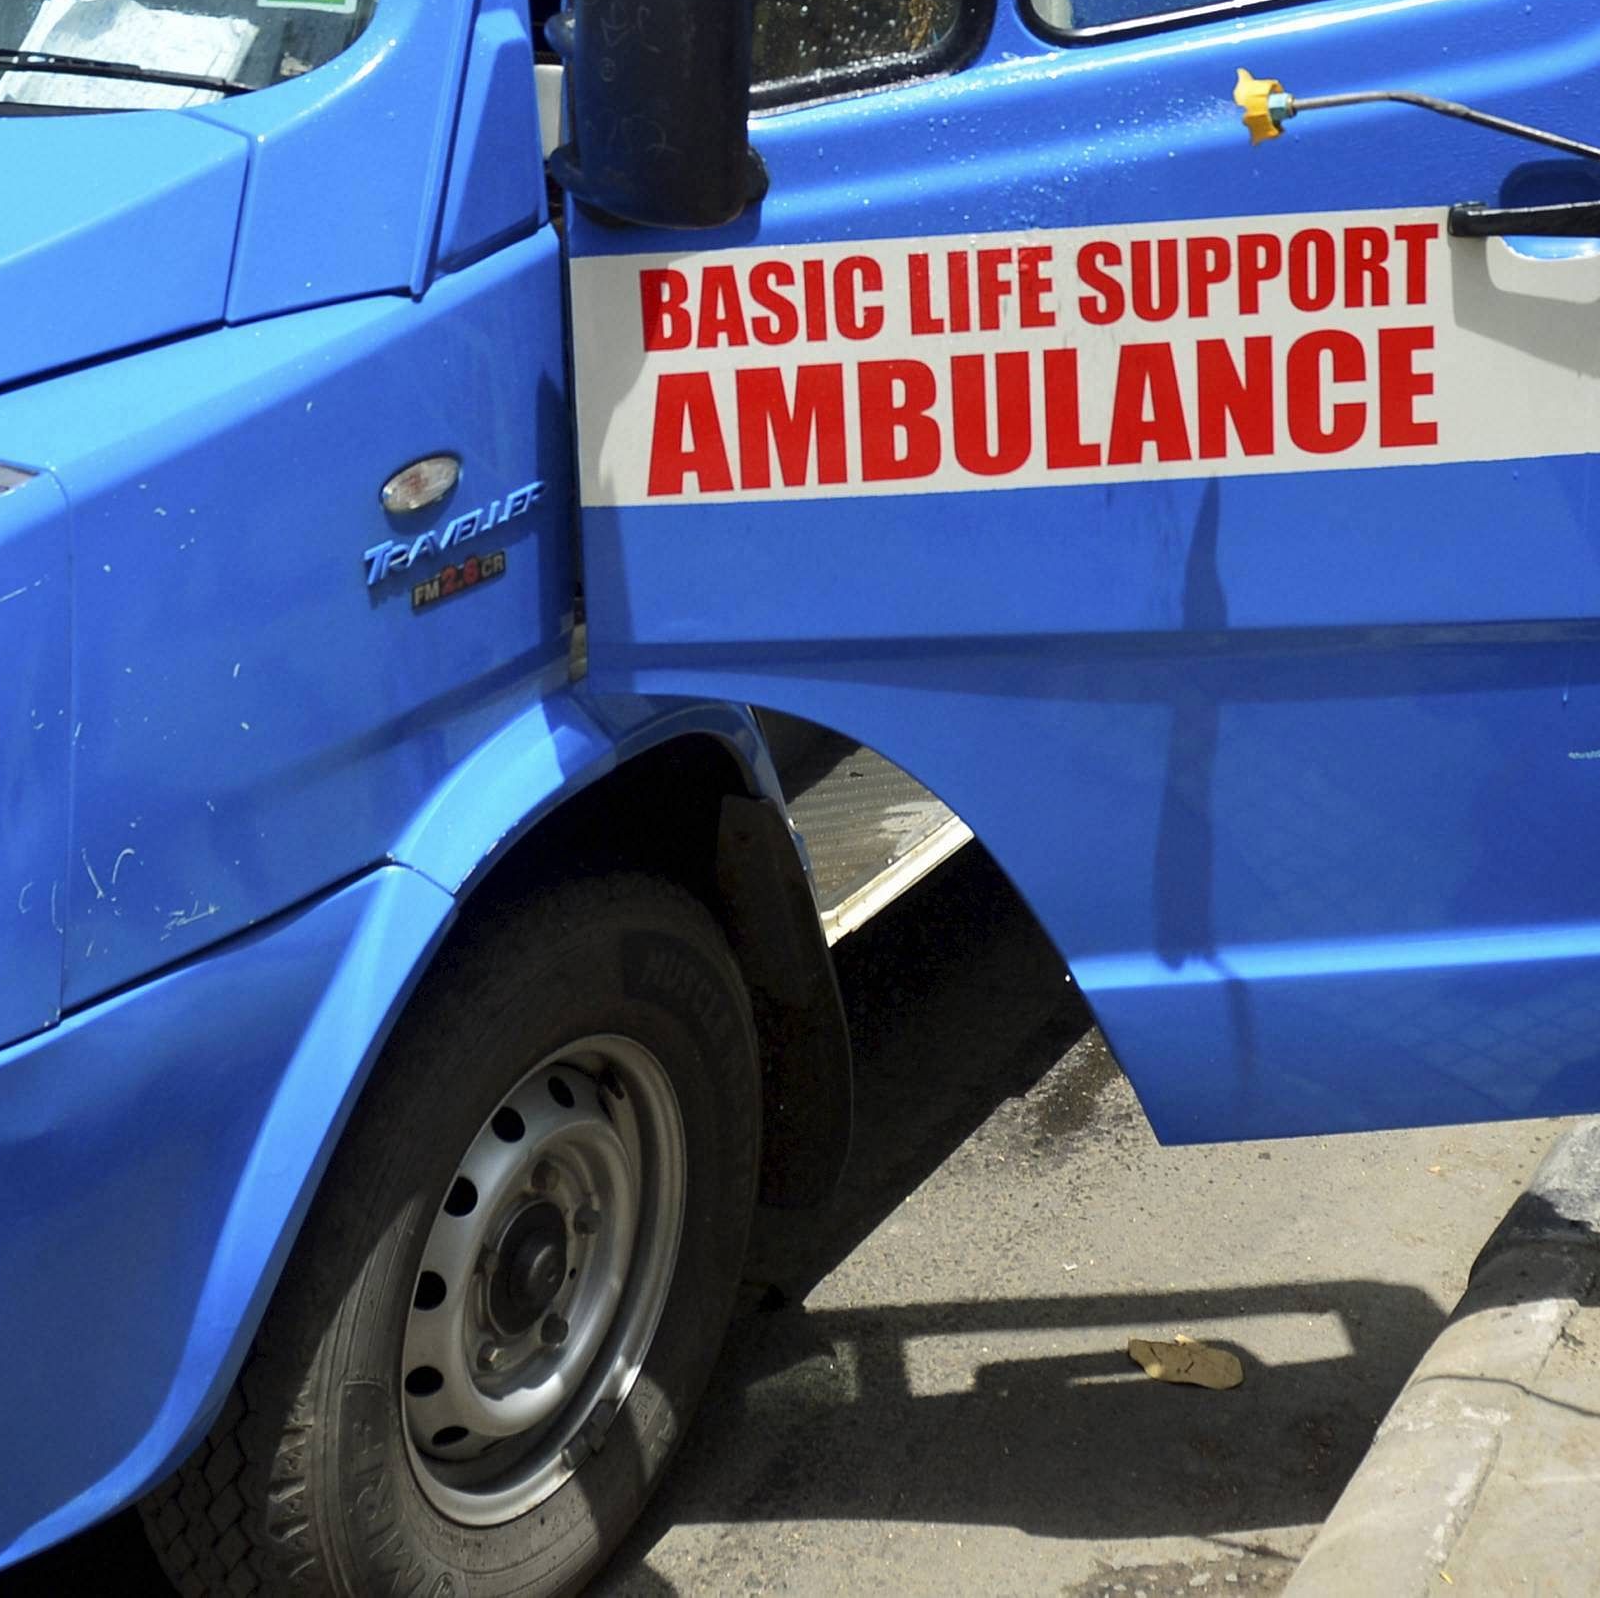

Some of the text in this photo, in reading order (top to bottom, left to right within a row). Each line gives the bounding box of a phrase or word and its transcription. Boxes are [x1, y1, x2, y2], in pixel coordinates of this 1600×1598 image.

[639, 223, 1440, 352] BASIC LIFE SUPPORT
[646, 326, 1439, 497] AMBULANCE
